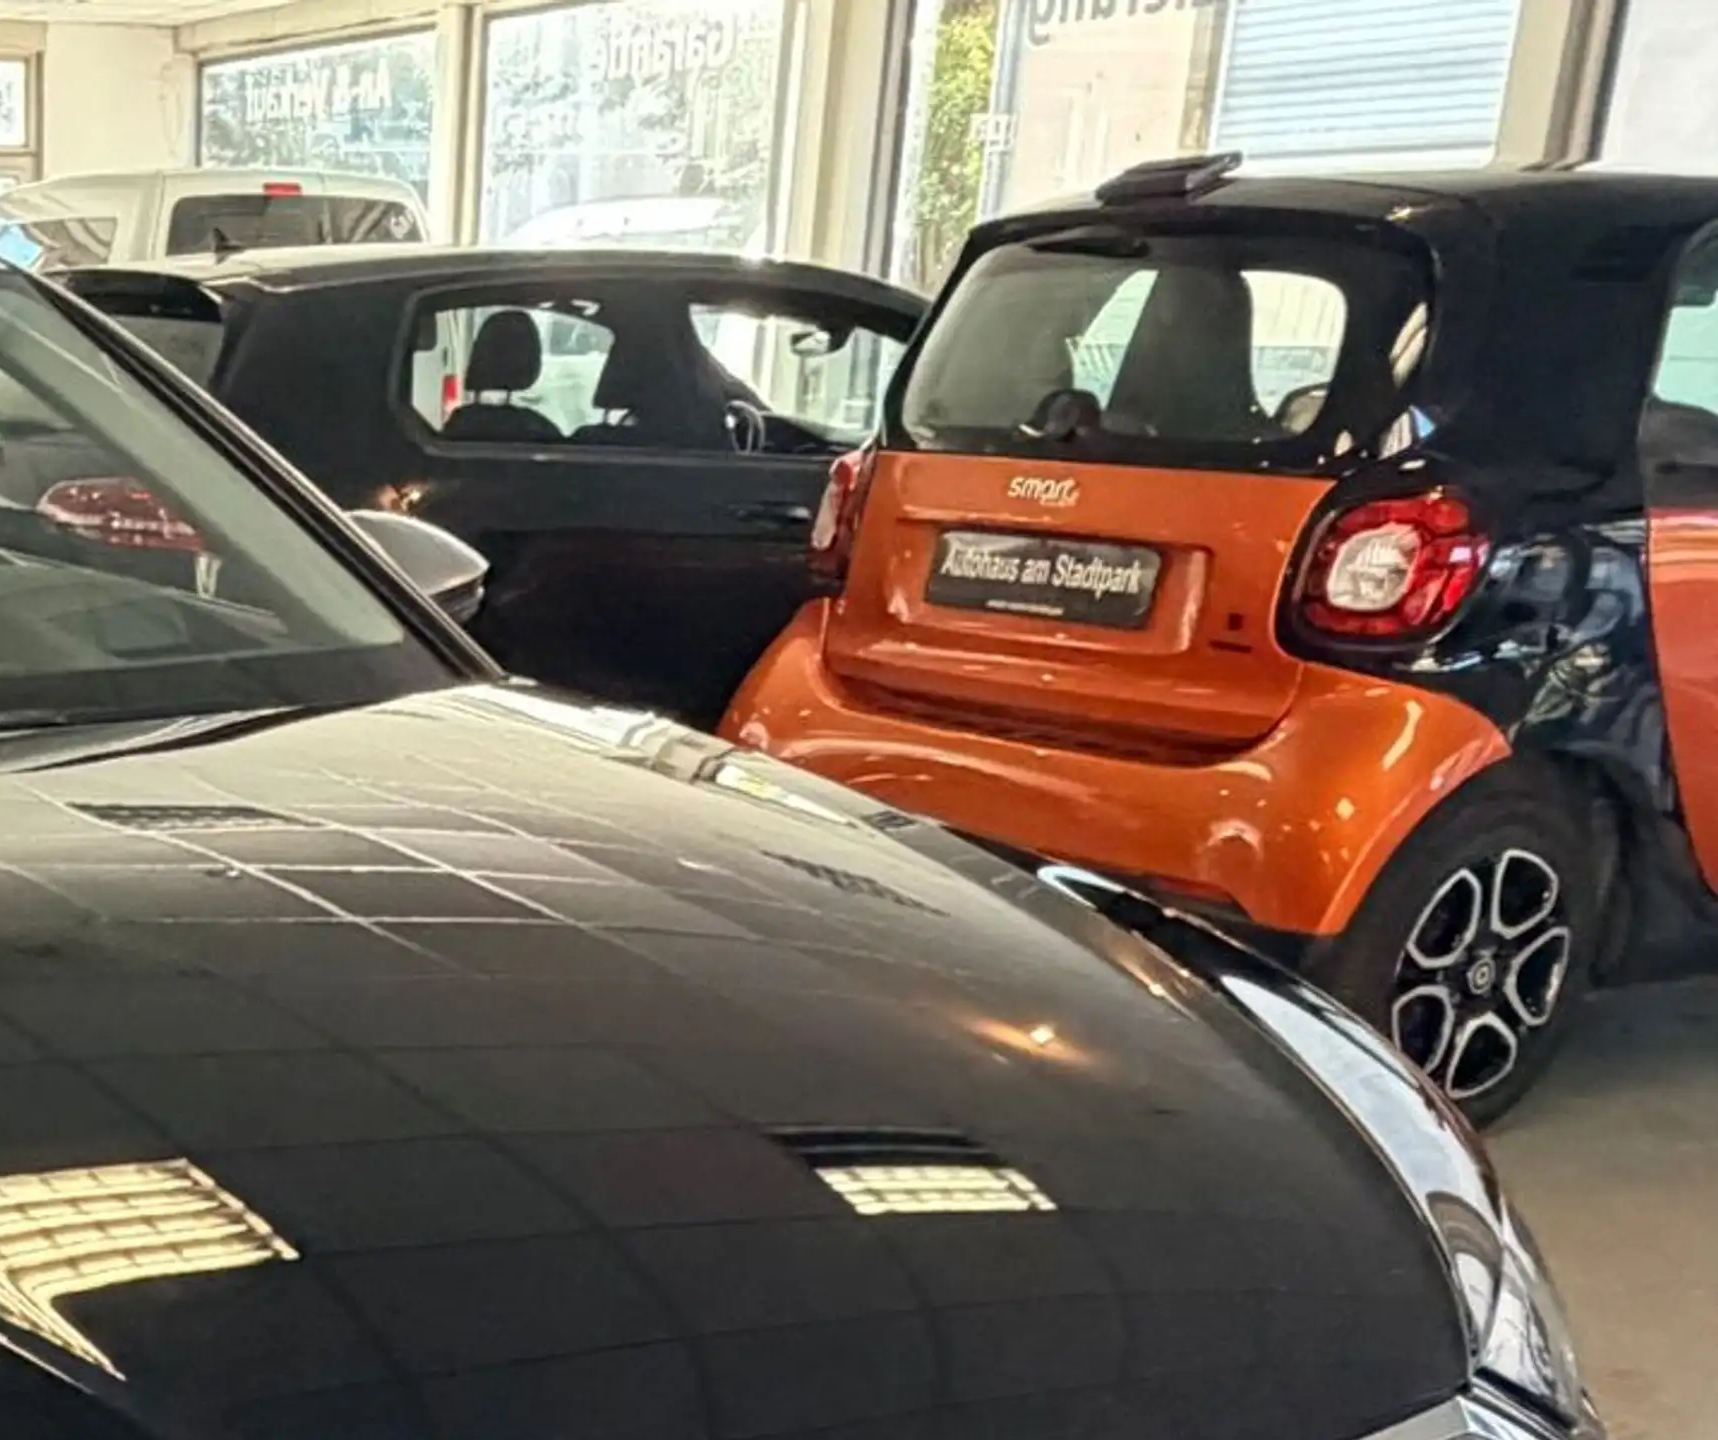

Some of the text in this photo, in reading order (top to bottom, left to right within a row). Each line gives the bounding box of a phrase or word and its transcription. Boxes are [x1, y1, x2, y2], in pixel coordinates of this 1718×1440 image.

[940, 542, 1143, 600] Autohaus am Stadtpark
